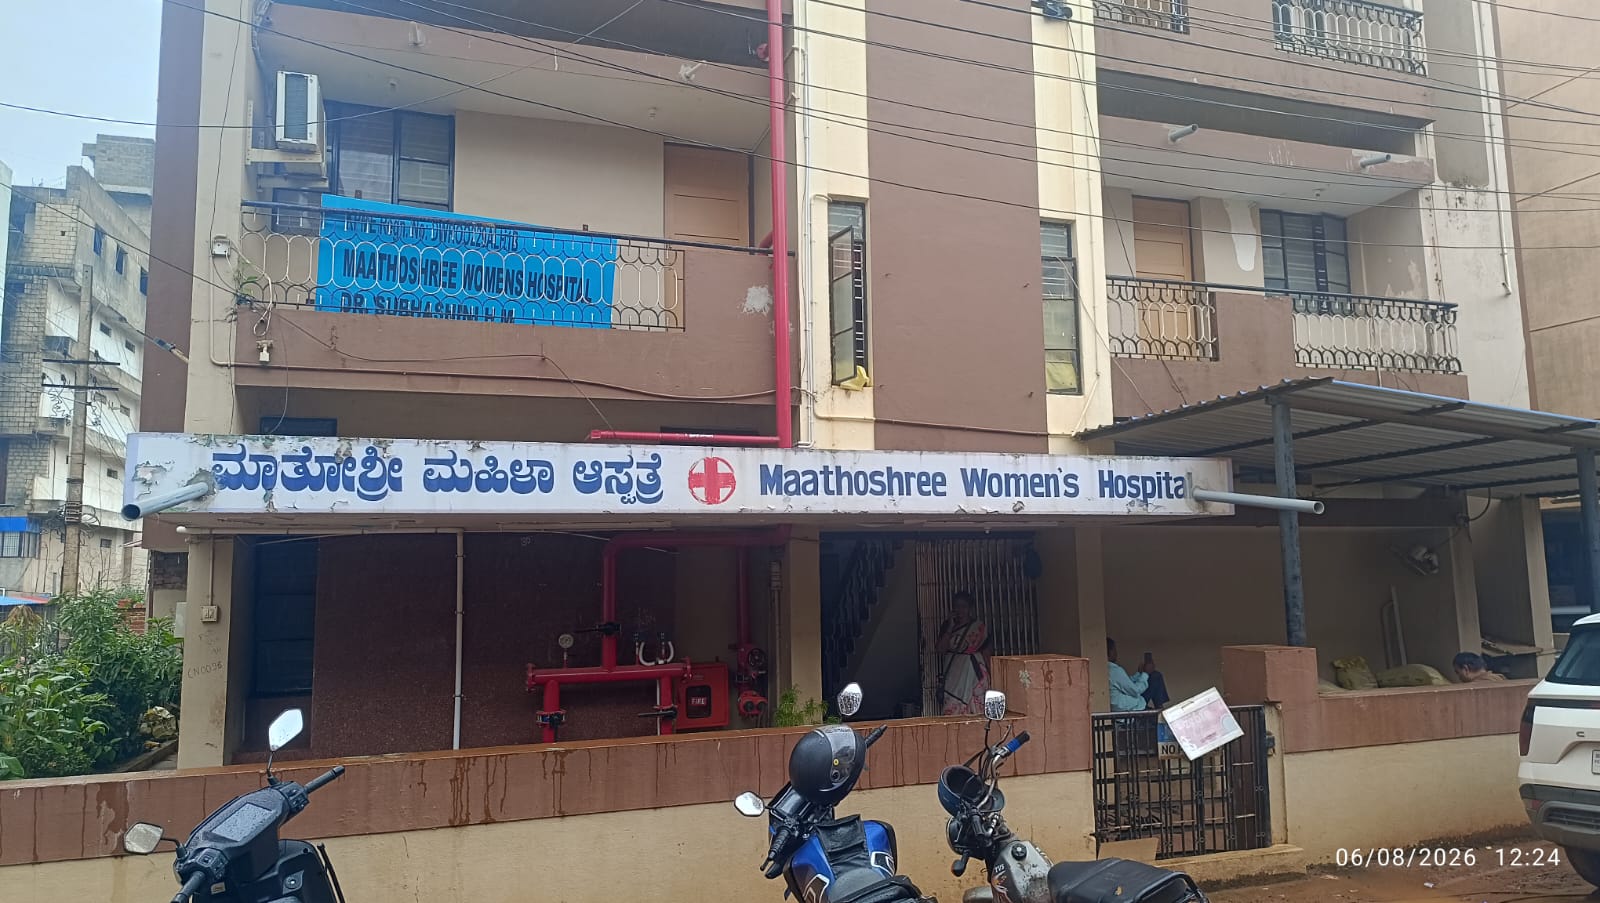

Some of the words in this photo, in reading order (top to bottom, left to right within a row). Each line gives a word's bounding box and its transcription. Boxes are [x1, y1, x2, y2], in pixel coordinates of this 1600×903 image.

[343, 249, 458, 289] MAATHOSHREE
[462, 263, 524, 298] WOMENS
[527, 271, 592, 303] HOSPITAL
[212, 443, 403, 501] ಮಾತೋಶ್ರೀ
[422, 449, 555, 495] ಮಹಿಳಾ
[572, 452, 663, 504] ಆಸ್ಪತ್ರೆ
[760, 464, 947, 498] Maathoshree
[959, 467, 1079, 498] Women's
[1161, 744, 1176, 754] NO
[994, 864, 1005, 873] TVS
